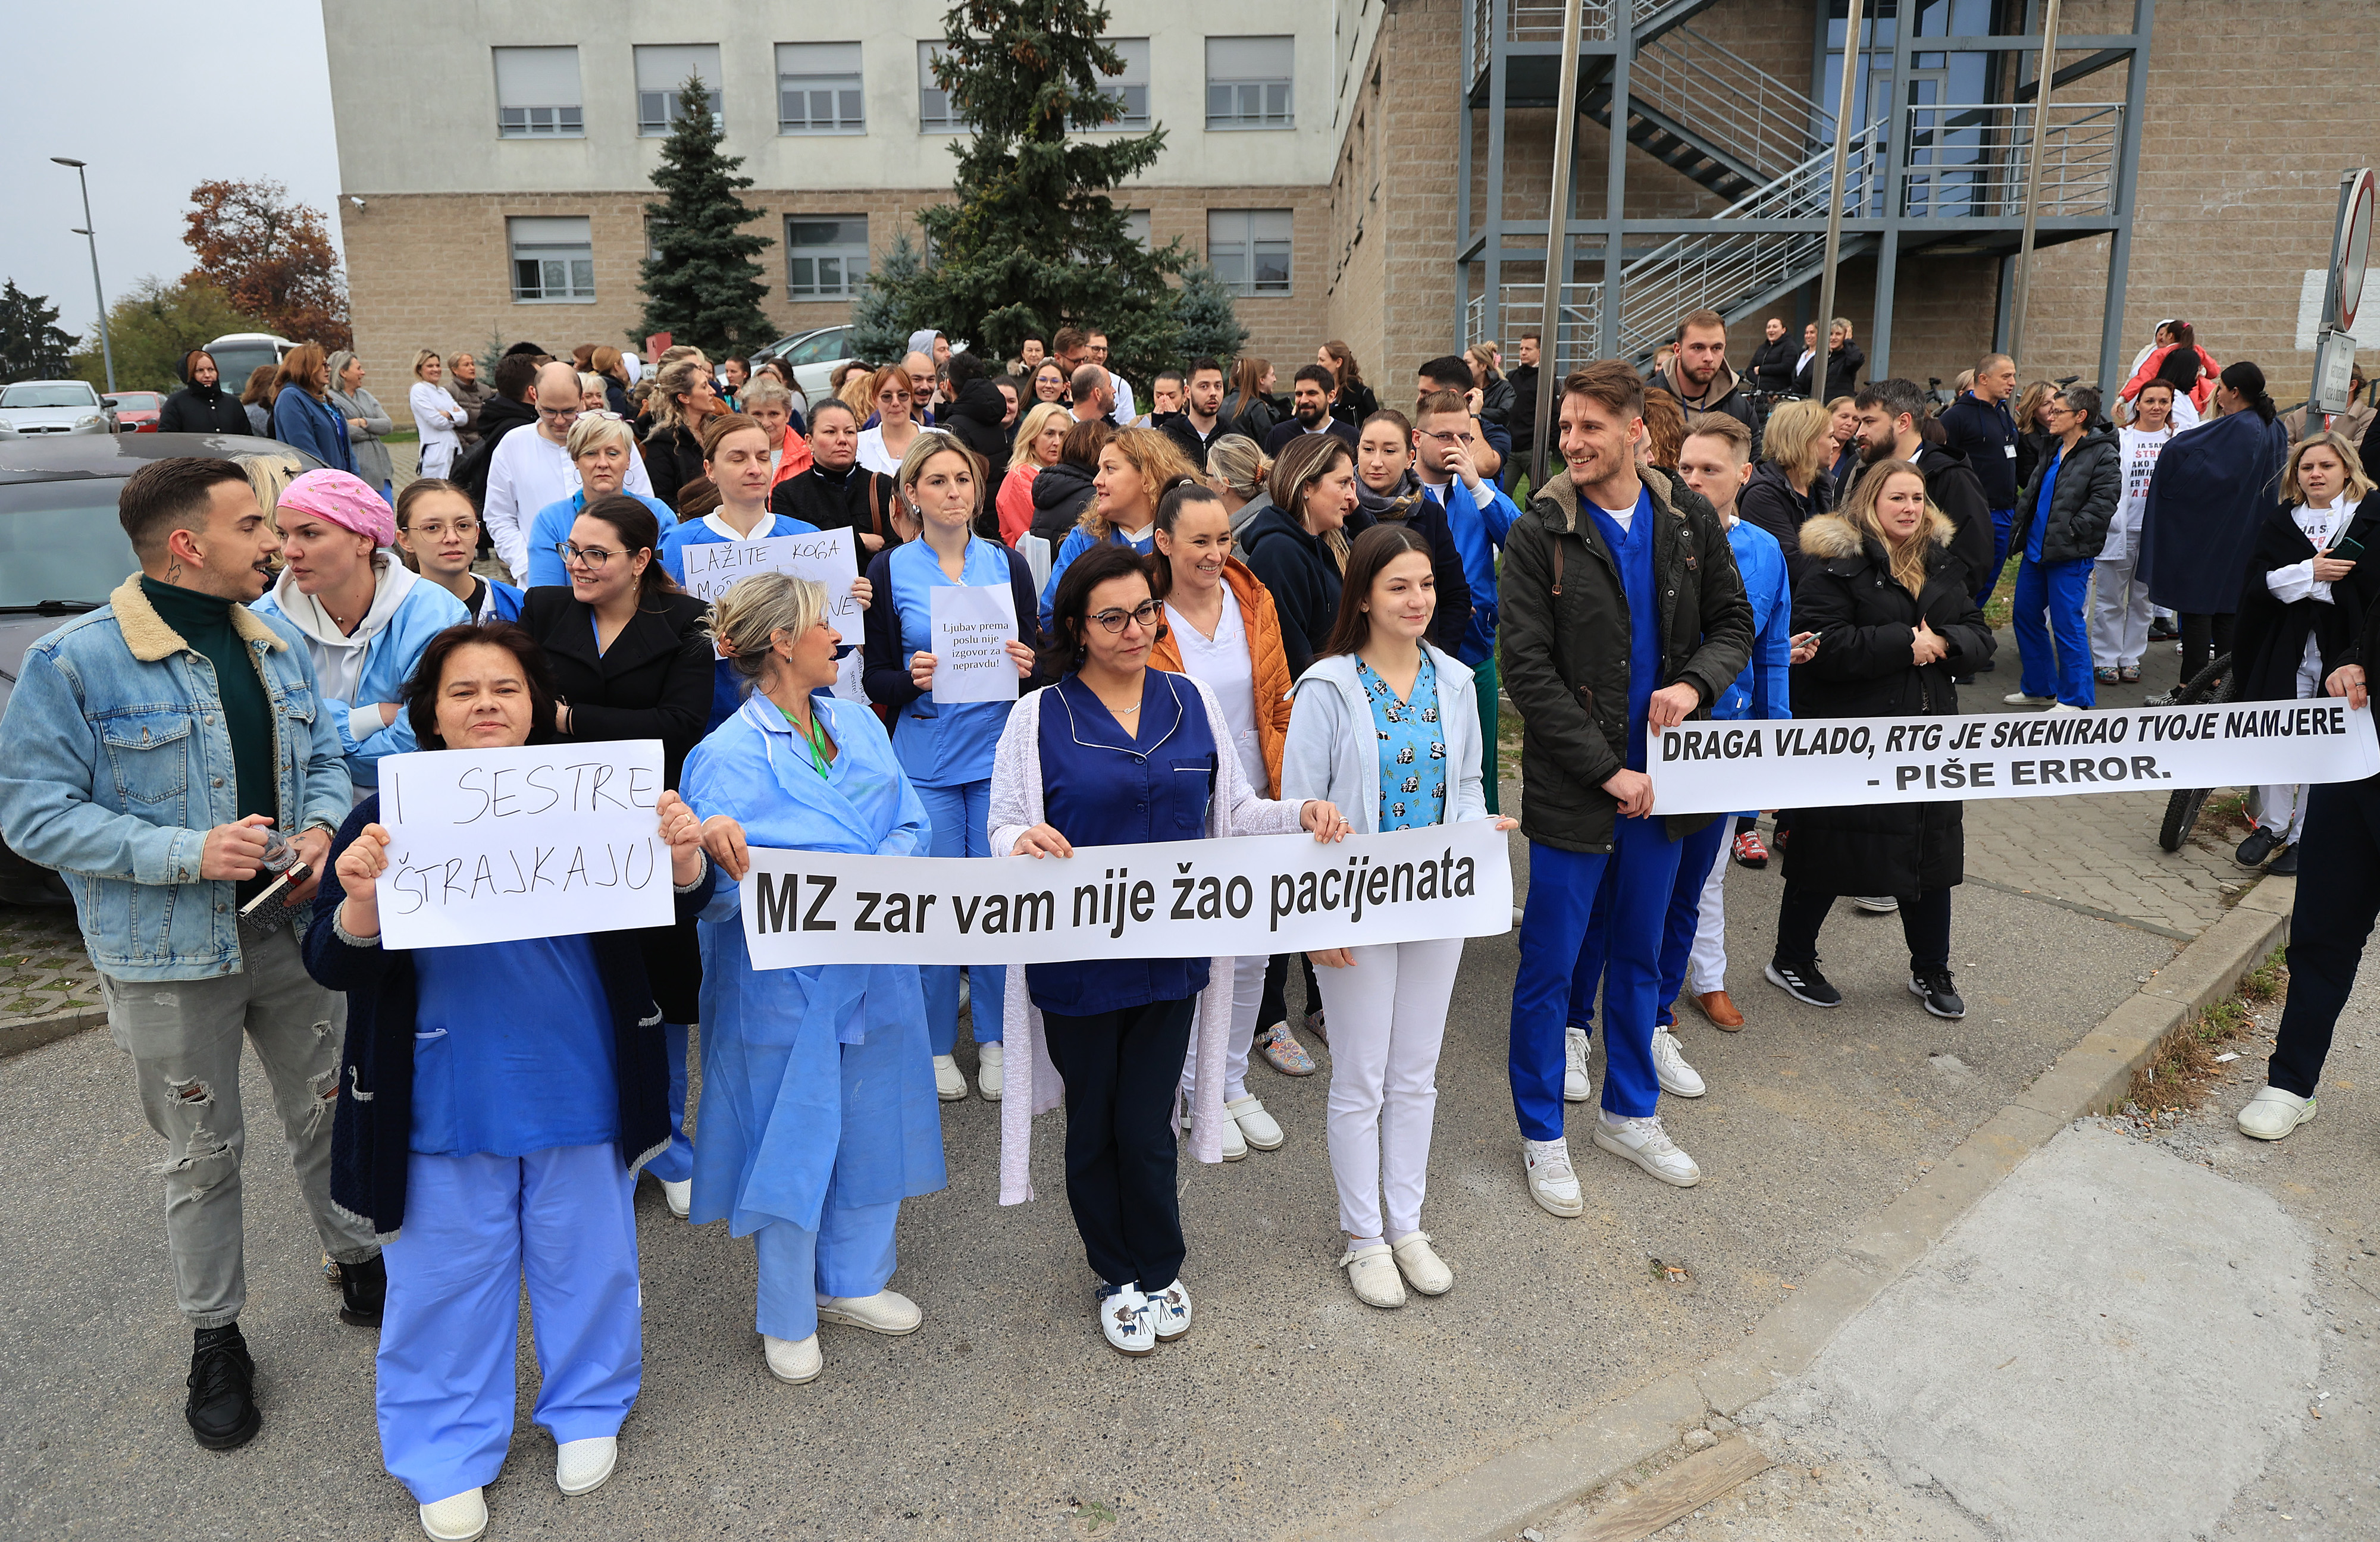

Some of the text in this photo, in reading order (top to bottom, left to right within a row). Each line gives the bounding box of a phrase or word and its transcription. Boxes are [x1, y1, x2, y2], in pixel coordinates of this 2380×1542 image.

[2132, 460, 2150, 468] AKO
[690, 540, 840, 573] LAŽITE KOGA
[943, 623, 1009, 634] Ljubav prema
[953, 634, 999, 647] poslu nije
[952, 649, 988, 659] izgovor
[953, 659, 1000, 671] nepravdu!
[1662, 707, 2346, 761] DRAGA VLADO, RTG JE SKENIRAO TVOJE NAMJERE
[1896, 757, 1995, 791] PIŠE
[2011, 756, 2172, 785] ERROR.
[395, 763, 655, 825] I SESTRE
[394, 837, 653, 914] ŠTRAJKAJU
[757, 846, 1475, 939] MZ zar vam nije žao pacijenata
